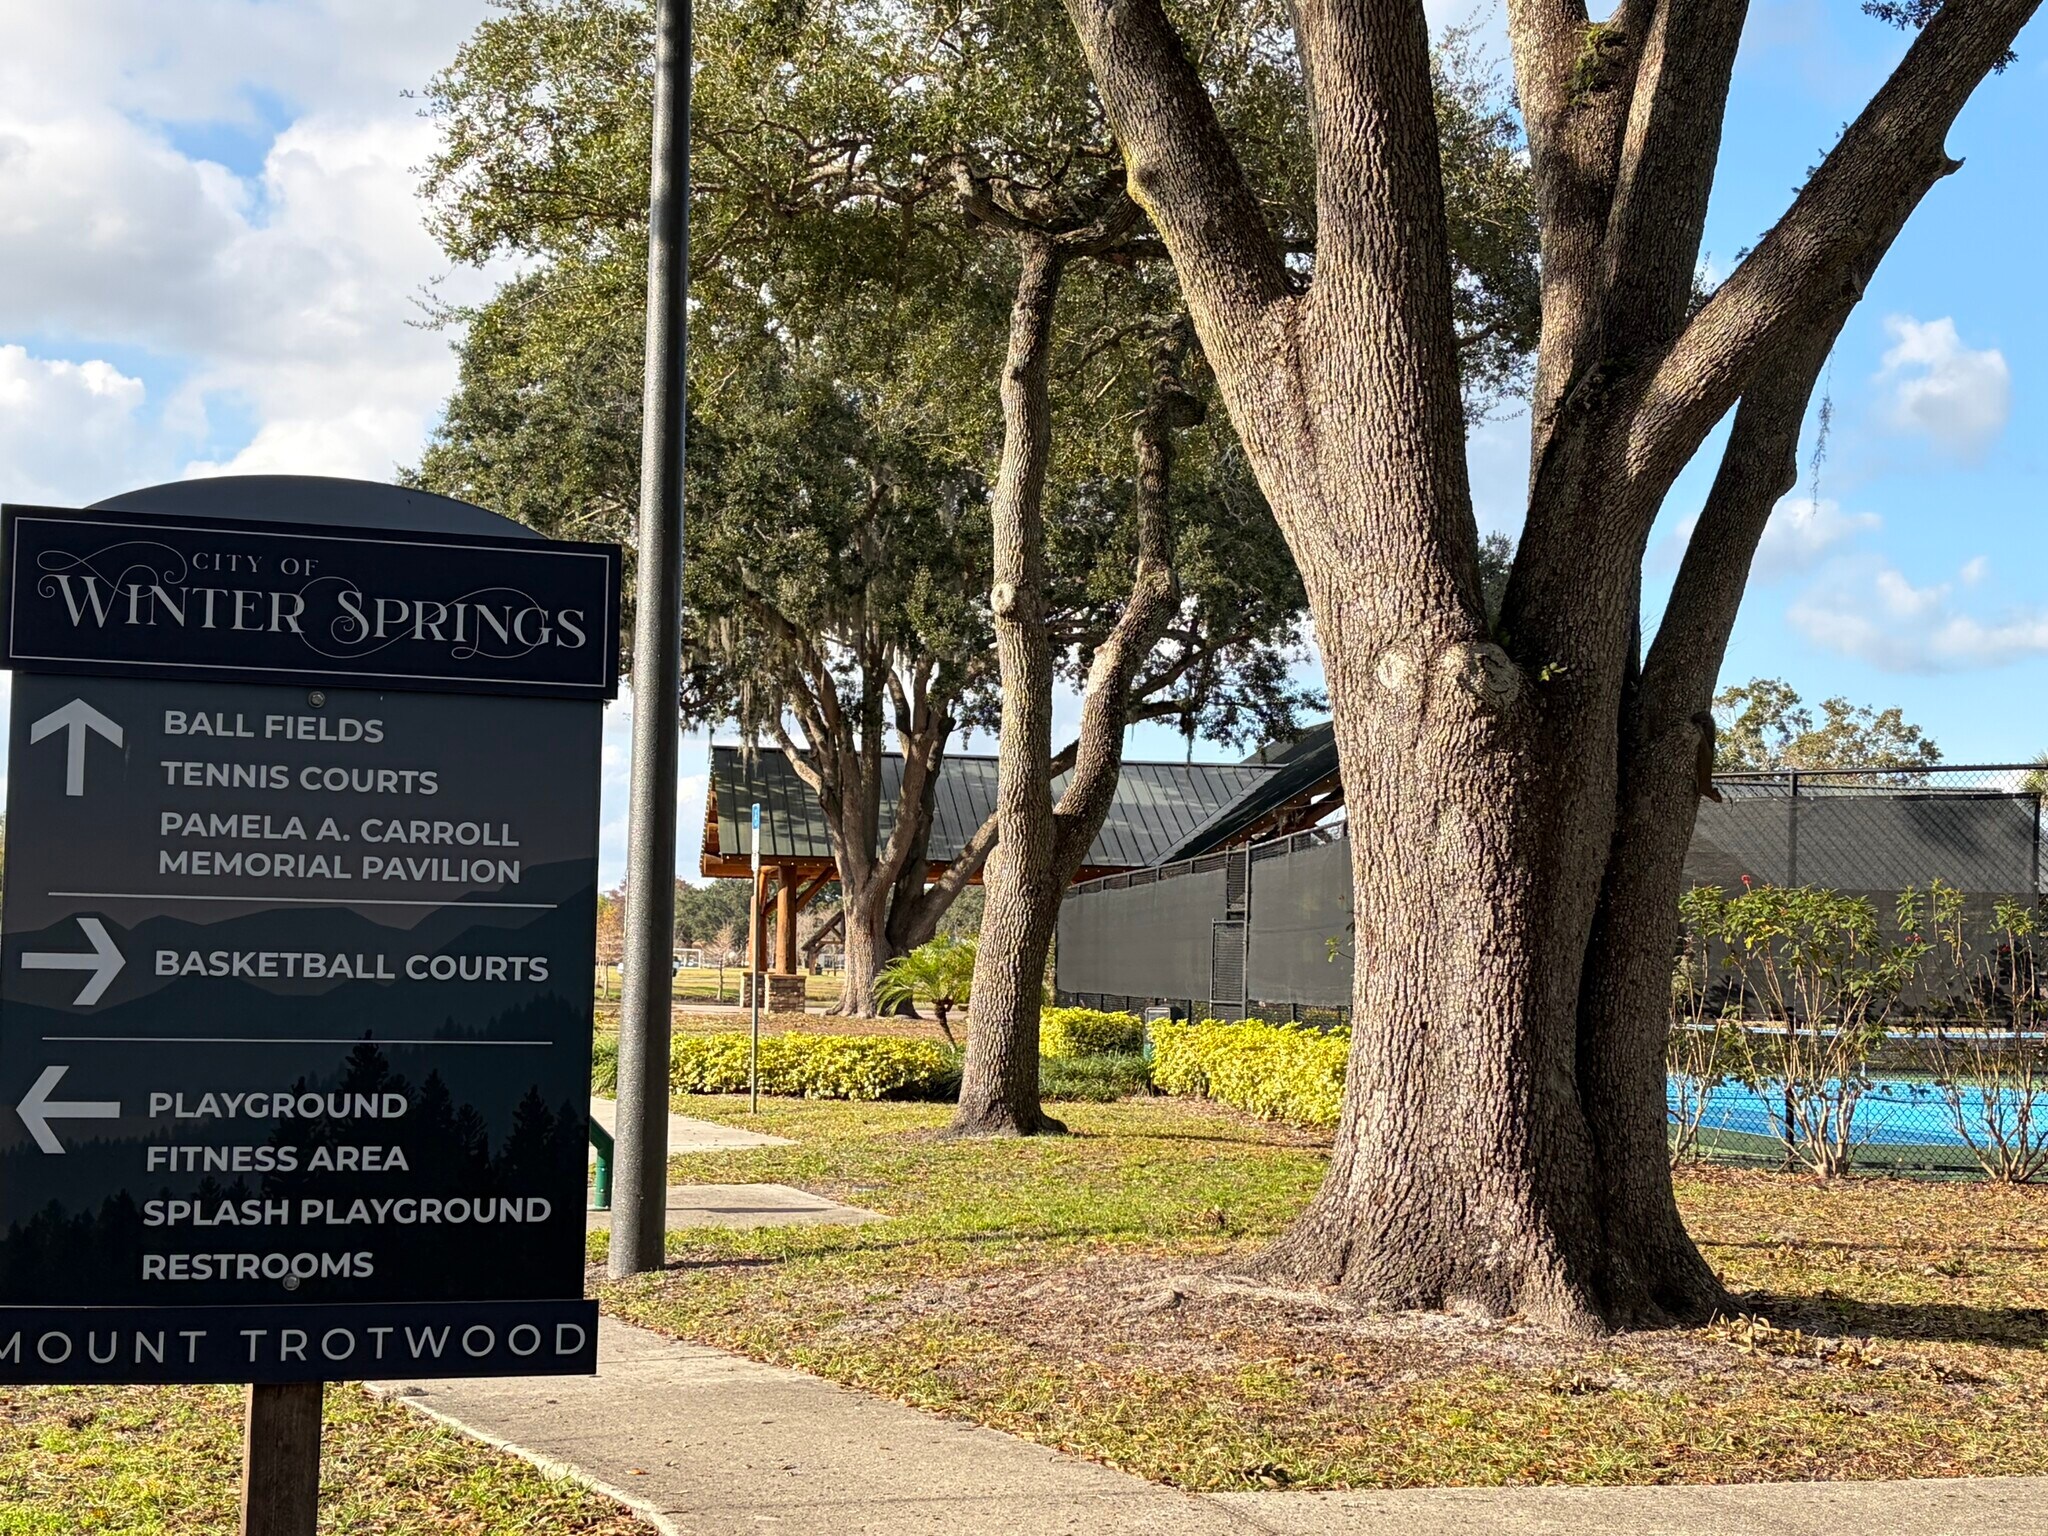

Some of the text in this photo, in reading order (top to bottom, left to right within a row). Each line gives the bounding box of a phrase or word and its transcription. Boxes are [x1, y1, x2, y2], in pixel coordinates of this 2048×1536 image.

[192, 551, 319, 577] CITY OF
[38, 573, 587, 648] WINTER SPRINGS
[164, 710, 384, 743] BALL FIELDS
[160, 761, 439, 795] TENNIS COURTS
[160, 811, 520, 847] PAMELA A. CARROLL
[159, 850, 520, 884] MEMORIAL PAVILION
[155, 950, 549, 982] BASKETBALL COURTS
[149, 1092, 408, 1119] PLAYGROUND
[146, 1145, 410, 1172] FITNESS AREA
[143, 1197, 552, 1227] SPLASH PLAYGROUND
[142, 1251, 374, 1281] RESTROOMS
[0, 1323, 586, 1364] MOUNT TROTWOOD
